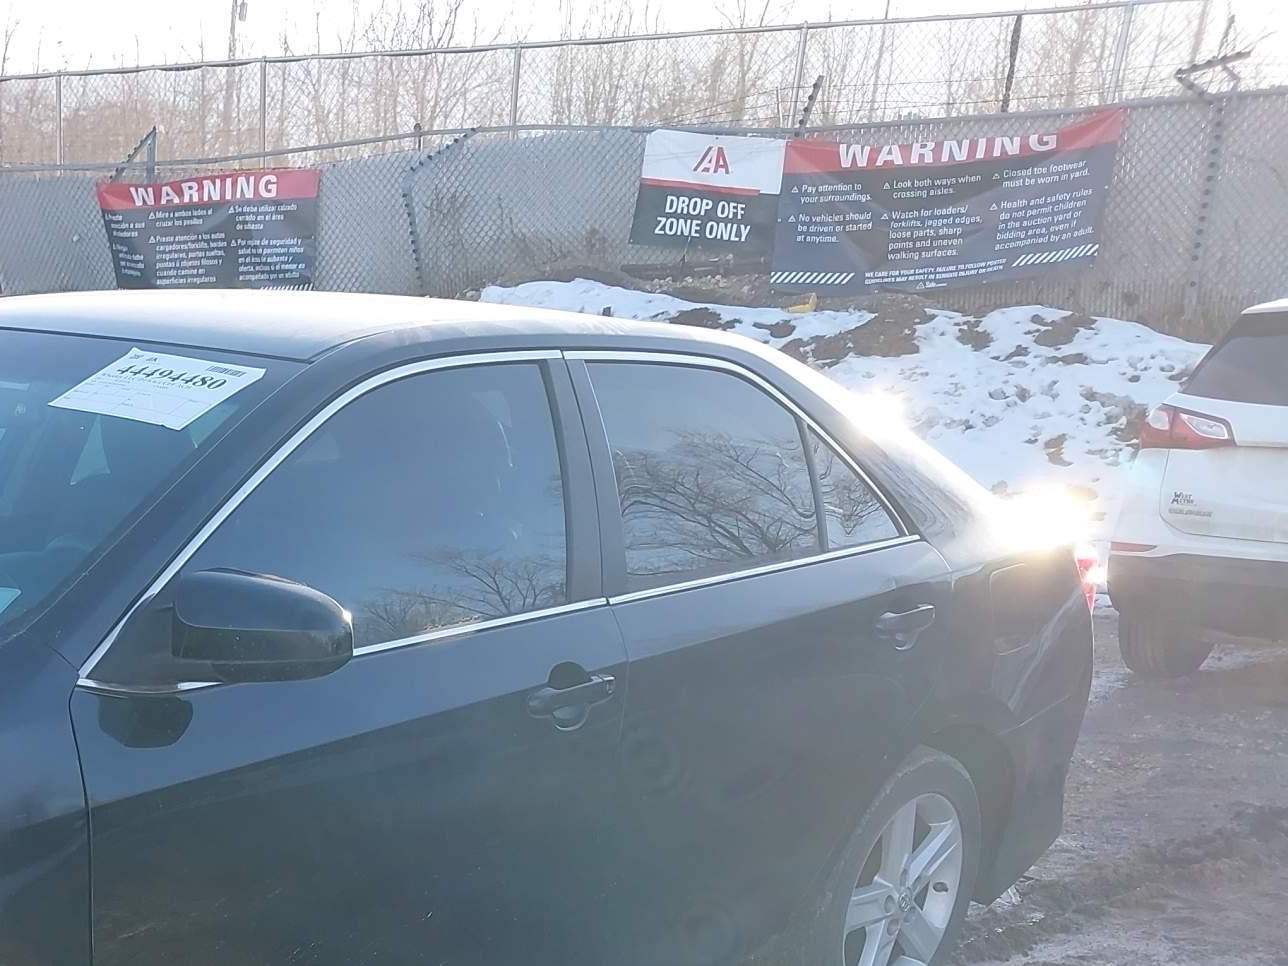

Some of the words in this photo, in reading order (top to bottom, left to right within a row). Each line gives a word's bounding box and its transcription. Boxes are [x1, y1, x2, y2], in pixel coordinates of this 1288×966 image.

[839, 134, 1057, 168] WARNING
[1002, 178, 1023, 188] must
[1025, 178, 1035, 186] be
[1037, 175, 1059, 185] worn
[1061, 173, 1069, 181] in
[1070, 168, 1090, 181] yard.
[1003, 167, 1032, 178] Closed
[1049, 160, 1087, 173] footwear
[129, 175, 278, 206] WARNING
[802, 184, 816, 194] Pay
[818, 183, 852, 192] attention
[893, 180, 912, 189] Look
[914, 178, 932, 188] both
[934, 177, 956, 186] ways
[957, 175, 982, 184] when
[800, 196, 818, 204] your
[819, 192, 872, 202] surroundings.
[892, 189, 928, 199] crossing
[1000, 199, 1028, 209] Health
[1029, 196, 1045, 206] and
[1046, 192, 1071, 203] safety
[1072, 188, 1093, 198] rules
[665, 195, 713, 216] DROP
[717, 201, 746, 220] OFF
[891, 210, 919, 219] Watch
[920, 209, 932, 217] for
[999, 212, 1011, 220] do
[1026, 206, 1053, 218] permit
[1054, 199, 1087, 211] children
[798, 214, 810, 222] No
[812, 213, 844, 222] vehicles
[845, 212, 872, 220] should
[924, 217, 953, 227] jagged
[1007, 221, 1020, 229] the
[1022, 216, 1052, 227] auction
[1053, 211, 1072, 223] yard
[1073, 210, 1082, 218] or
[654, 217, 702, 237] ZONE
[705, 221, 751, 242] ONLY
[797, 224, 808, 232] be
[809, 224, 834, 232] driven
[845, 221, 873, 231] started
[889, 230, 911, 239] loose
[938, 227, 962, 236] sharp
[996, 230, 1026, 241] bidding
[1050, 223, 1070, 233] even
[1071, 219, 1077, 228] if
[888, 241, 914, 251] points
[915, 238, 931, 248] and
[932, 237, 963, 247] uneven
[994, 236, 1049, 251] accompanied
[1050, 234, 1060, 242] by
[1061, 232, 1072, 240] an
[887, 250, 919, 260] walking
[921, 248, 959, 258] surfaces.
[117, 365, 227, 390] 44494480
